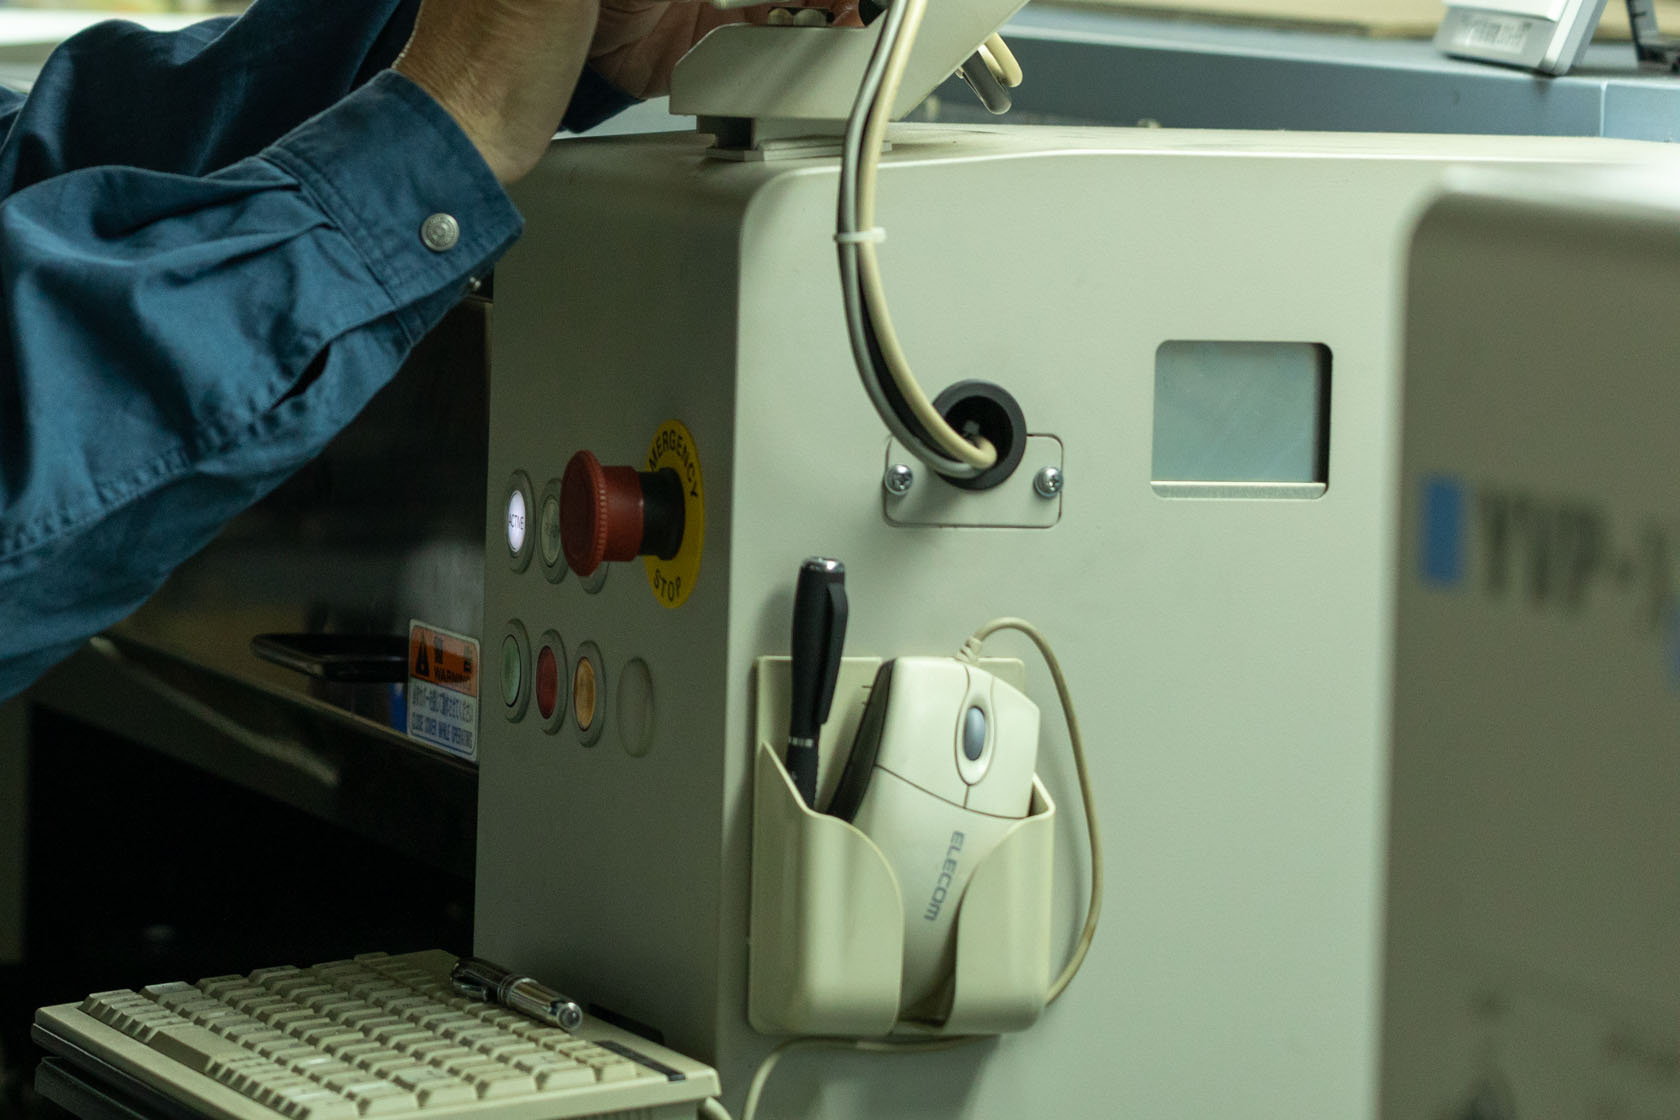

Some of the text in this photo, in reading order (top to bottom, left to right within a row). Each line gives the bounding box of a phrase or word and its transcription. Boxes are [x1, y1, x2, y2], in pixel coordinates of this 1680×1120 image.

[648, 429, 699, 497] MERGENCY
[654, 568, 681, 602] STOP
[434, 665, 472, 688] WARNING
[924, 830, 964, 921] ELECOM
